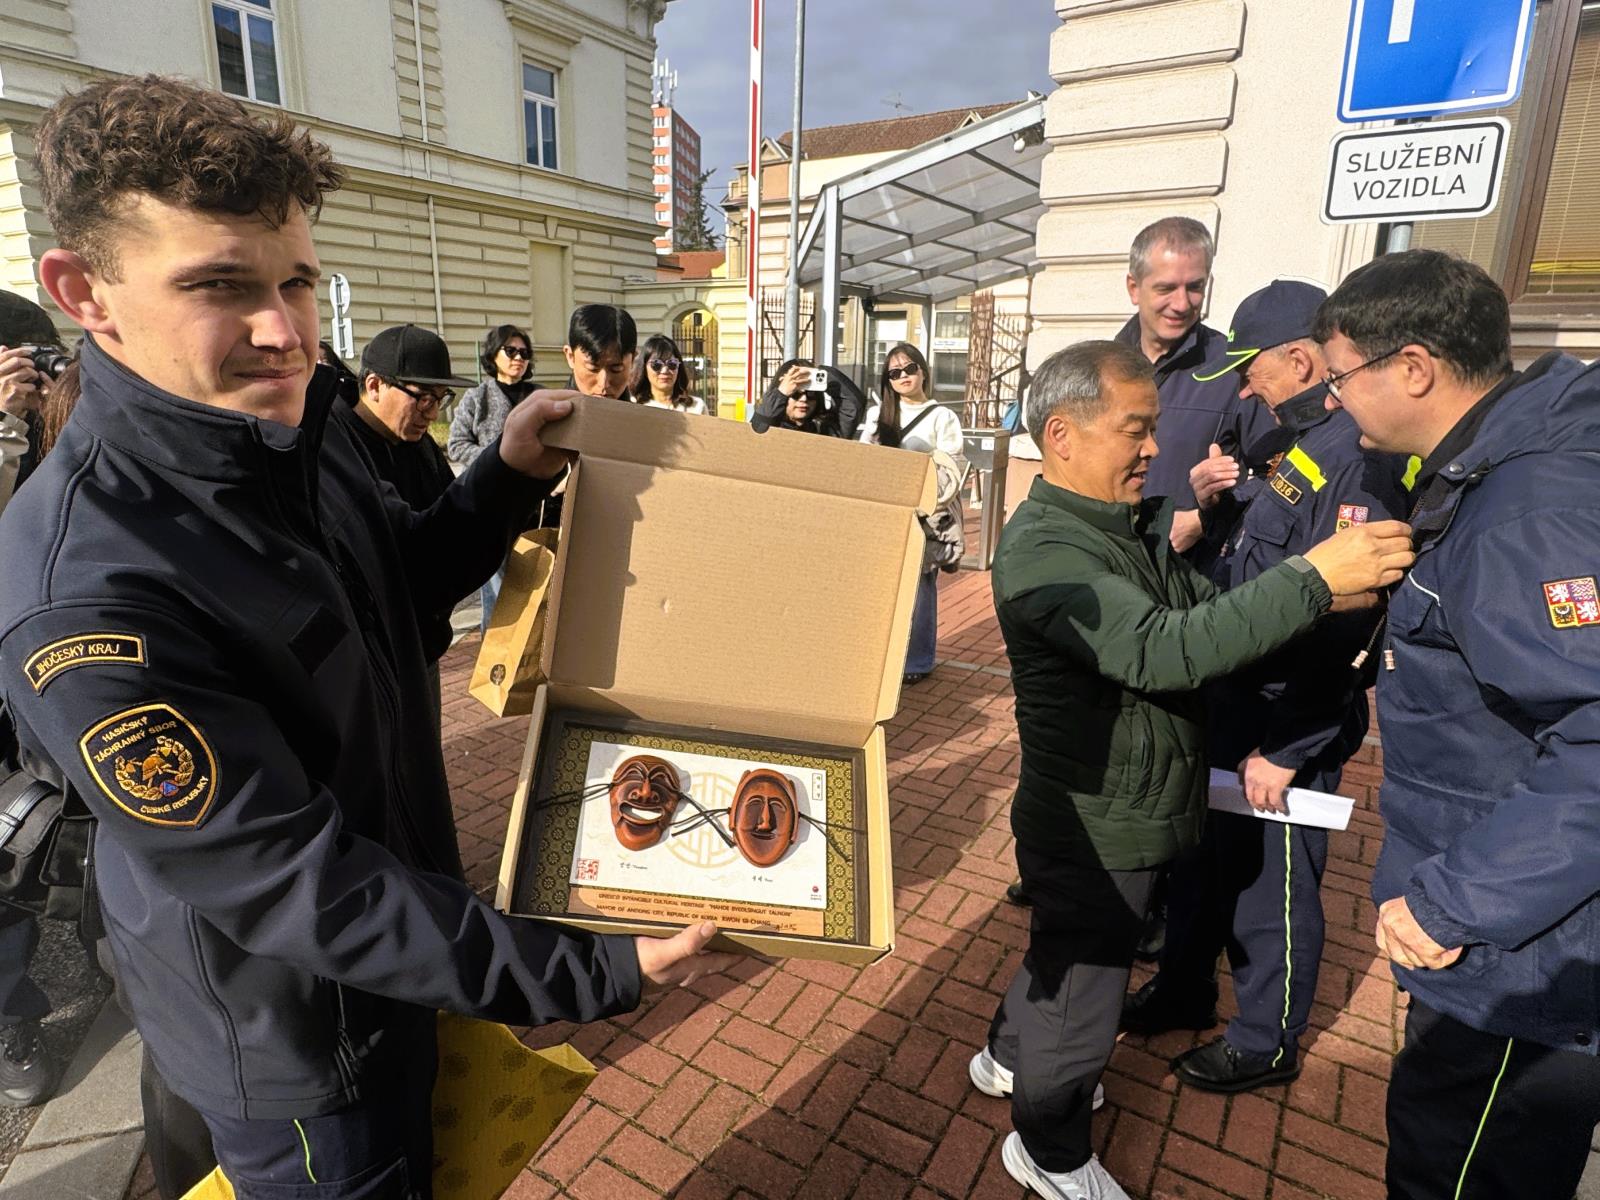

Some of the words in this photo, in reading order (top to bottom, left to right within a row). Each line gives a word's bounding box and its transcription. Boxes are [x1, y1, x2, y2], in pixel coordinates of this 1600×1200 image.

[1346, 136, 1487, 173] SLUŽEBNÍ
[1353, 174, 1466, 201] VOZIDLA
[35, 643, 84, 676] JIHOČESKÝ
[88, 643, 120, 655] KRAJ
[148, 720, 177, 735] SBOR
[172, 776, 209, 810] REPUBLIKY
